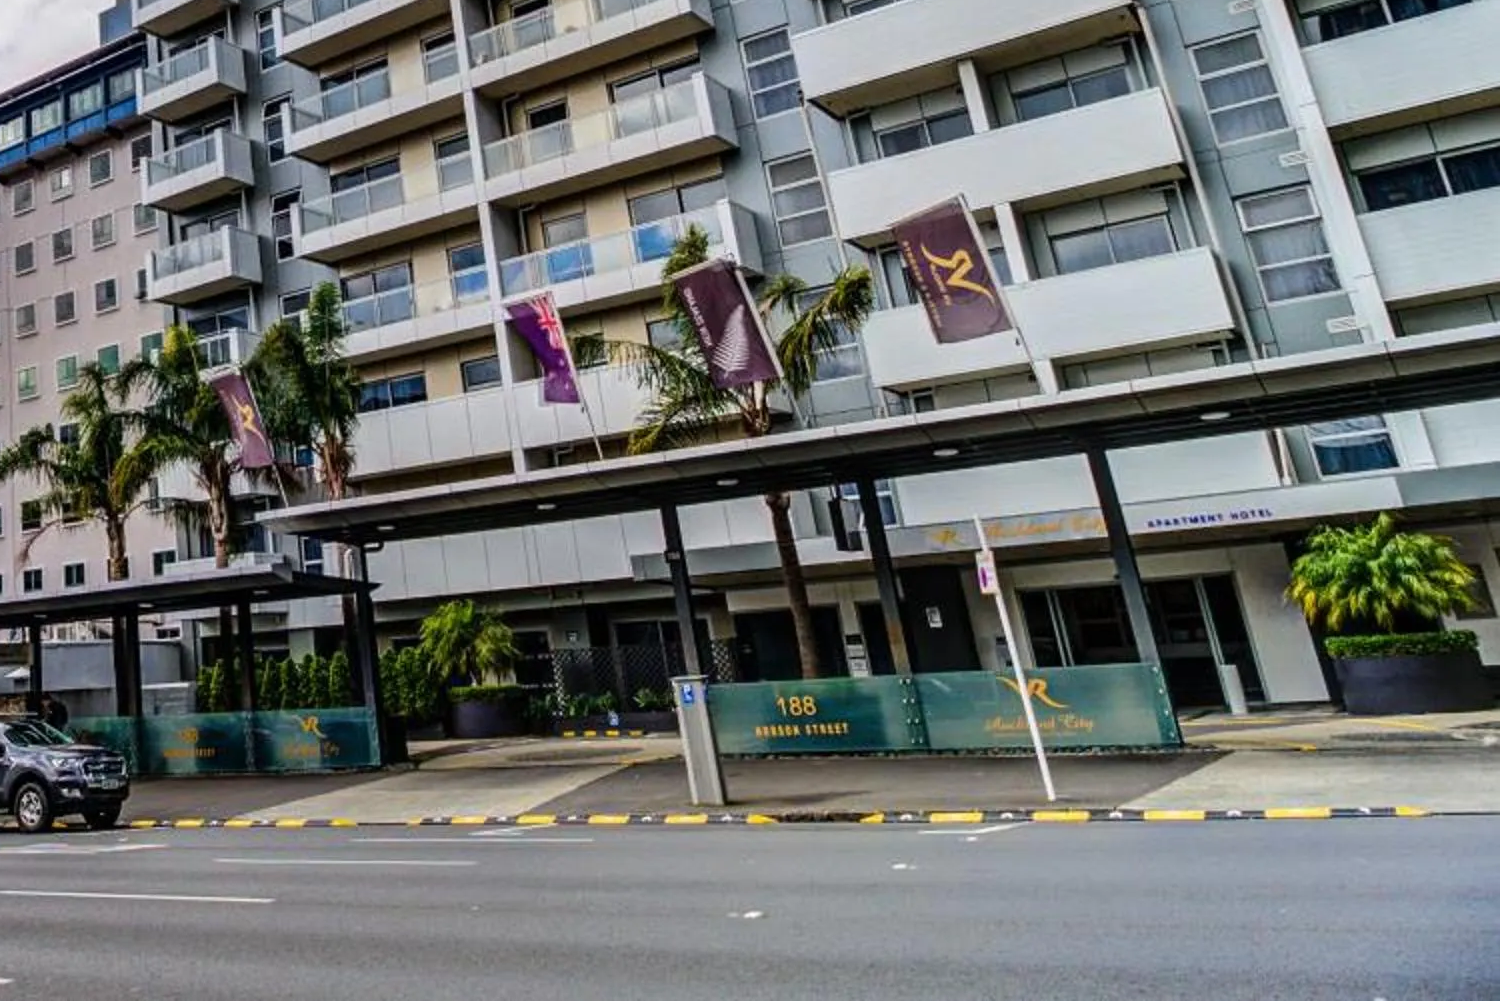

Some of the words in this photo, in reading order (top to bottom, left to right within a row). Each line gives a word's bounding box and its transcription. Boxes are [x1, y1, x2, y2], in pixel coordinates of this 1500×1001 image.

[1147, 512, 1223, 528] APARTMENT
[1229, 508, 1273, 520] HOTEL
[776, 696, 817, 716] 188
[805, 722, 849, 736] STREET
